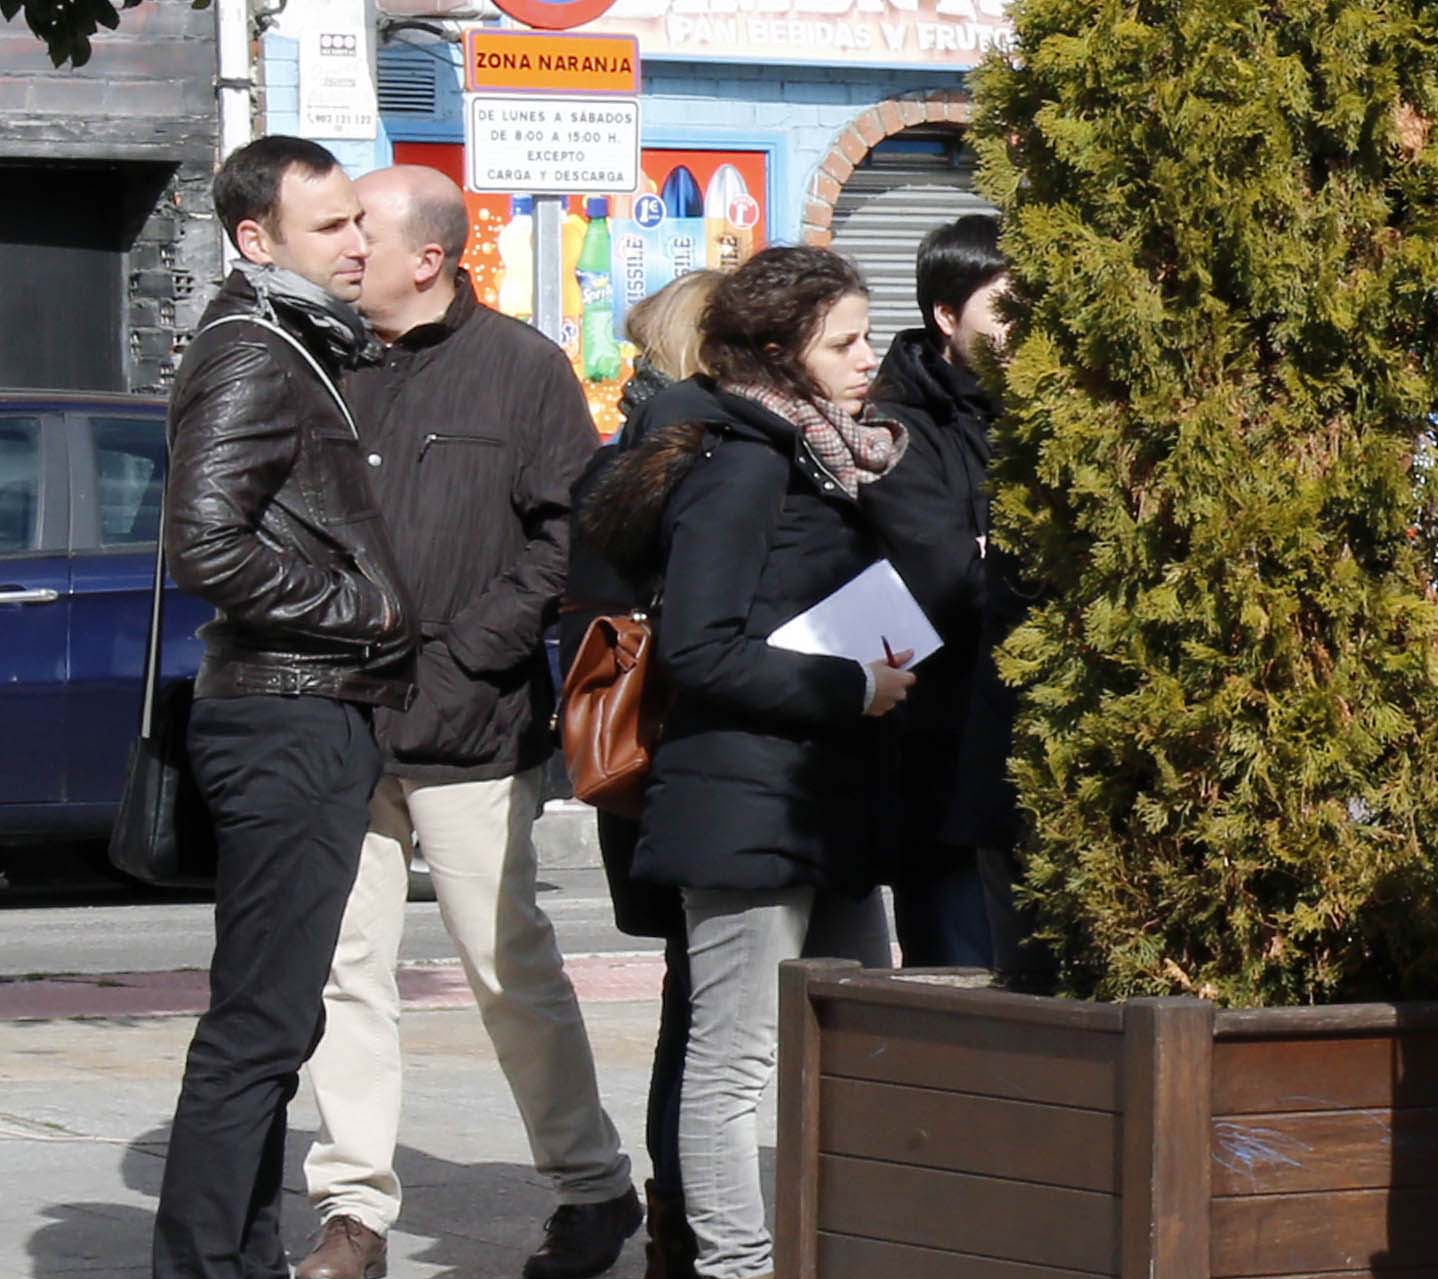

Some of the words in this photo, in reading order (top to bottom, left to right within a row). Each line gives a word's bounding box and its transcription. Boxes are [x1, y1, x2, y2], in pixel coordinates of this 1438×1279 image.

[669, 19, 737, 48] PAN
[751, 20, 872, 50] BEBIDAS
[880, 22, 909, 51] Y
[476, 52, 532, 70] ZONA
[538, 55, 632, 73] NARANJA
[478, 109, 494, 121] DE
[502, 111, 546, 122] LUNES
[554, 112, 562, 122] A
[571, 110, 632, 124] SÁBADOS
[490, 130, 507, 141] DE
[552, 131, 560, 142] A
[527, 150, 585, 162] EXCEPTO
[487, 169, 532, 180] CARGA
[540, 170, 547, 181] Y
[555, 170, 624, 182] DESCARGA
